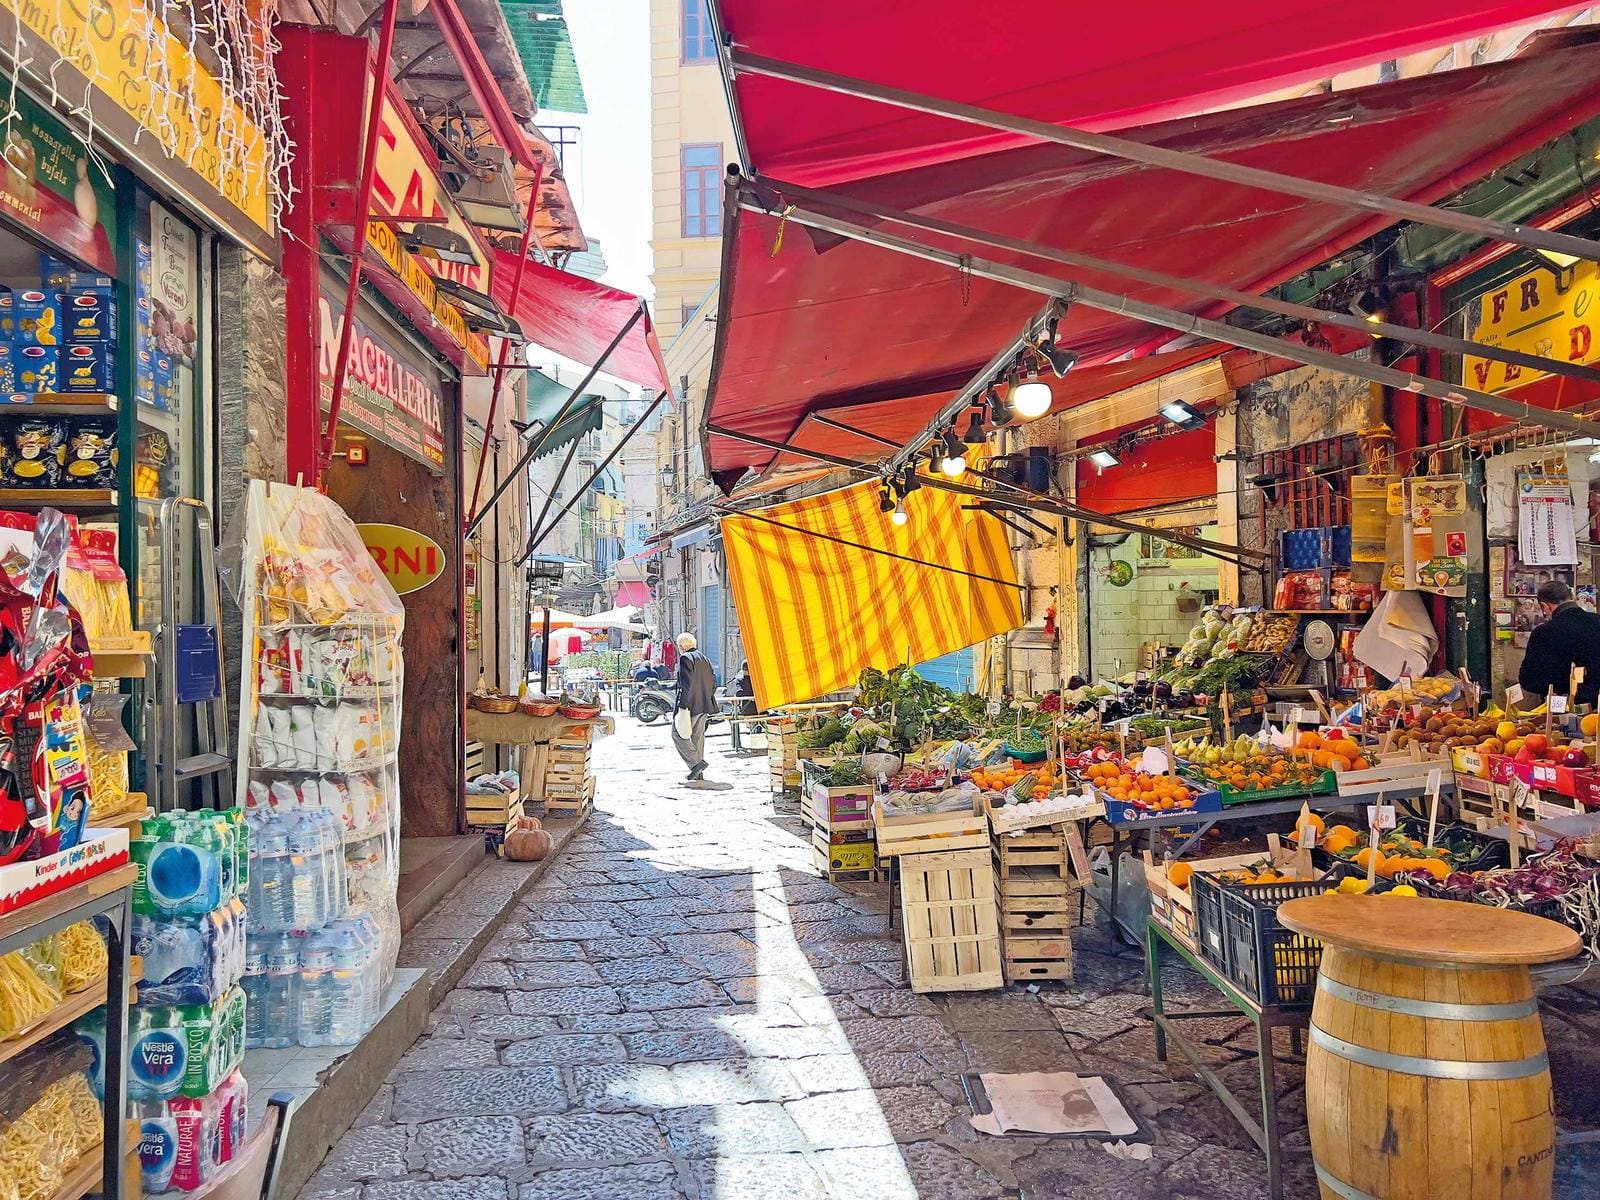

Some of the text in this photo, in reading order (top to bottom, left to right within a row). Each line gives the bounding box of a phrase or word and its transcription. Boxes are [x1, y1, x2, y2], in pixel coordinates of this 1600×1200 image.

[319, 297, 443, 436] MACELLERIA
[35, 860, 58, 878] Kinder
[143, 1053, 175, 1065] Vera
[188, 1029, 205, 1076] IN BOSCO
[143, 1132, 165, 1143] estlé
